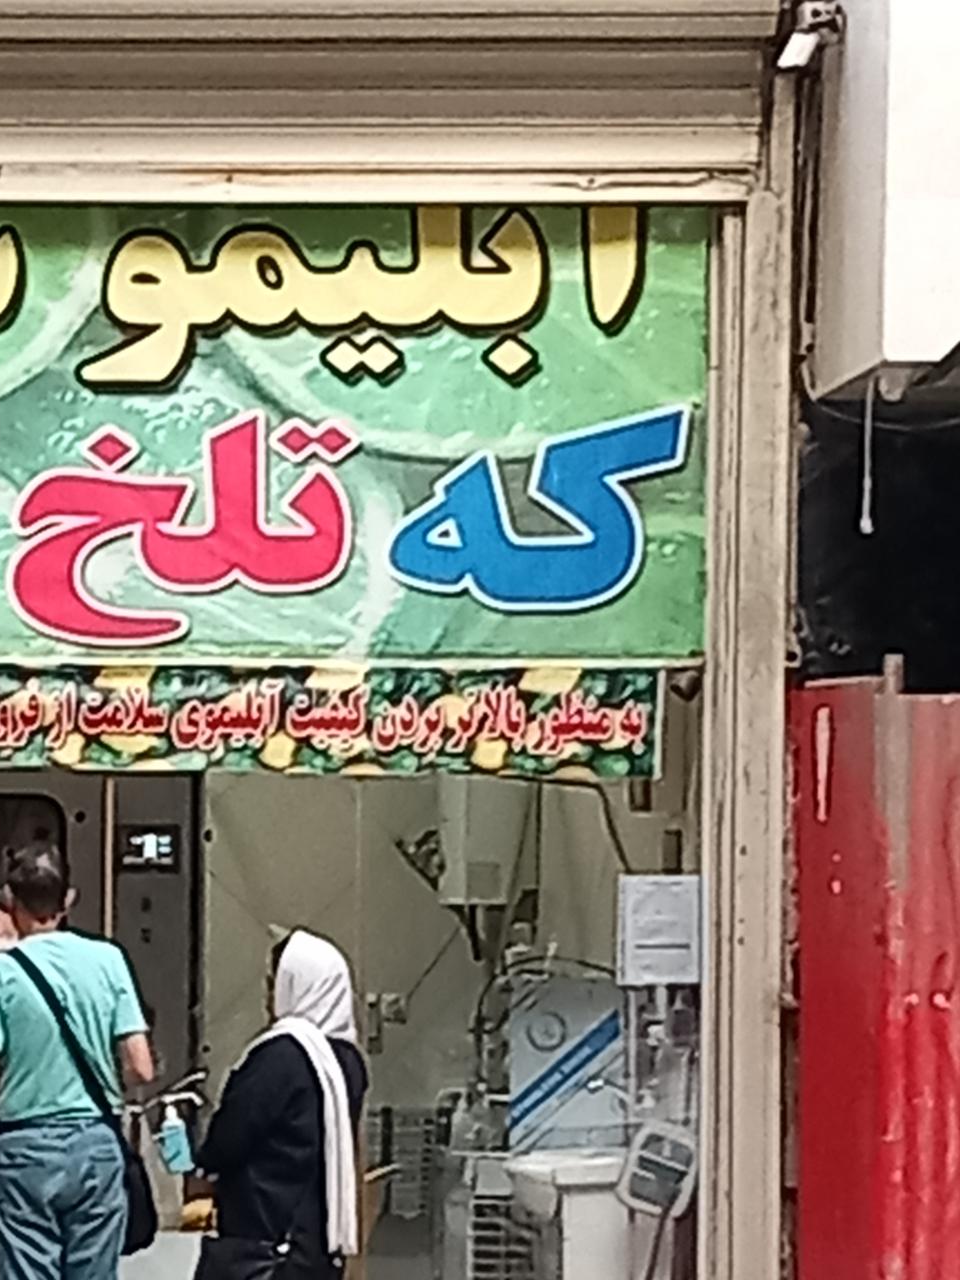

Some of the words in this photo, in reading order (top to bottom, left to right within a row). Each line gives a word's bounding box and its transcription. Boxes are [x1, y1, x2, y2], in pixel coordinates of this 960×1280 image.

[5, 408, 361, 648] تلخ
[388, 405, 692, 615] که
[44, 680, 76, 748] از
[77, 684, 168, 735] سلامت
[286, 684, 368, 750] کیفیت
[528, 690, 614, 756] منظور
